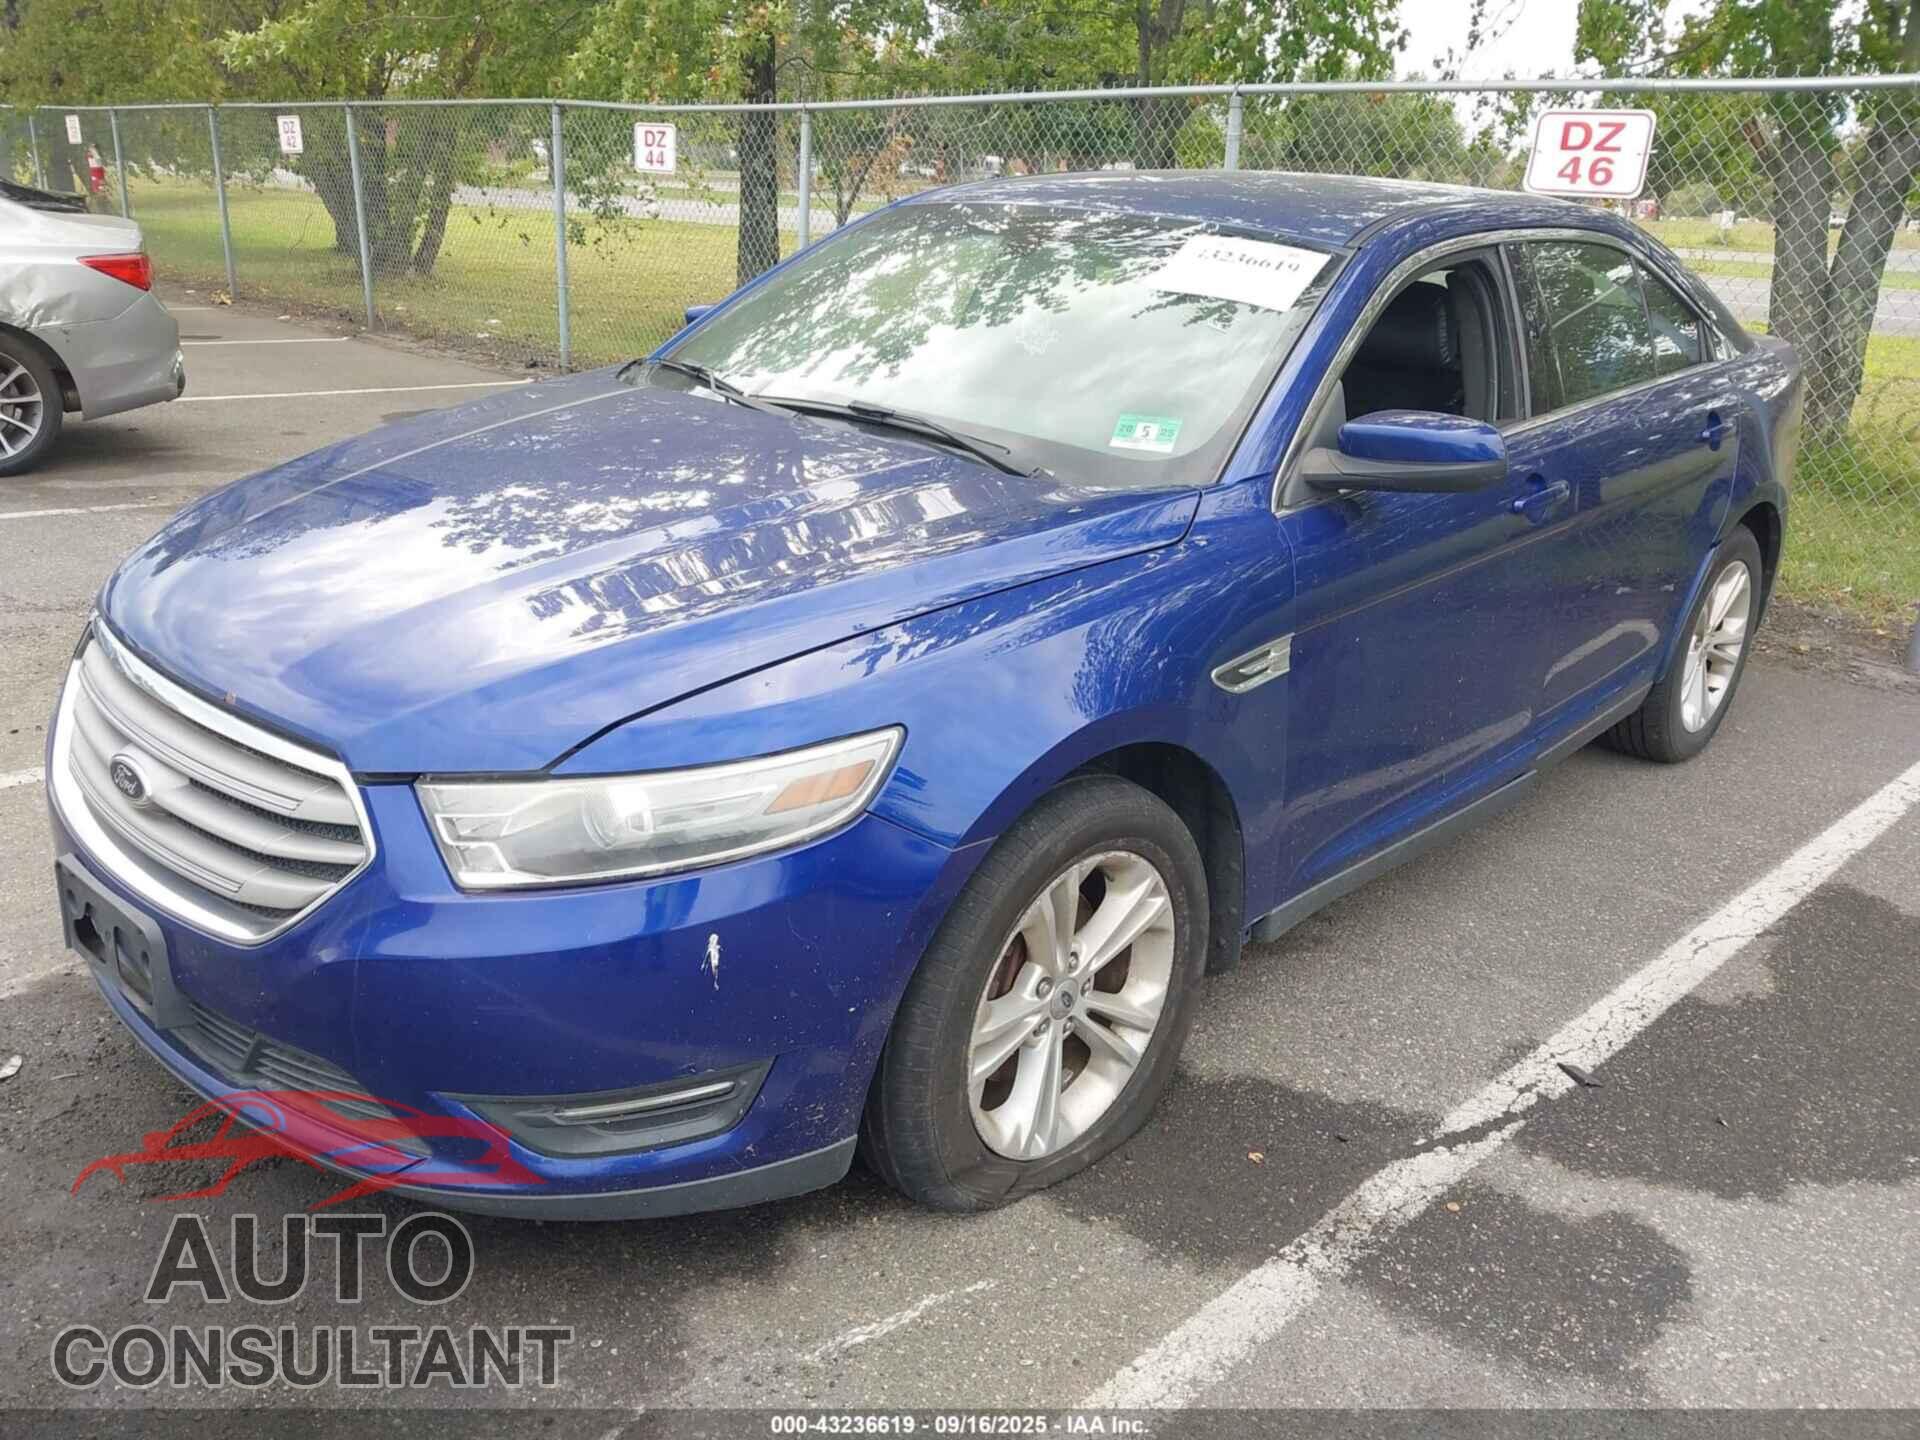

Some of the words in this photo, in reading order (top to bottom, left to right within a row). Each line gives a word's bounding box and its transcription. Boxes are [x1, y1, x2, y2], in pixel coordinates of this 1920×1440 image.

[282, 120, 297, 135] DZ
[287, 135, 297, 149] 42
[644, 130, 667, 148] DZ
[1559, 121, 1627, 152] DZ
[645, 150, 665, 166] 44
[1556, 156, 1615, 186] 46
[1141, 425, 1152, 438] 5
[113, 764, 138, 795] Ford
